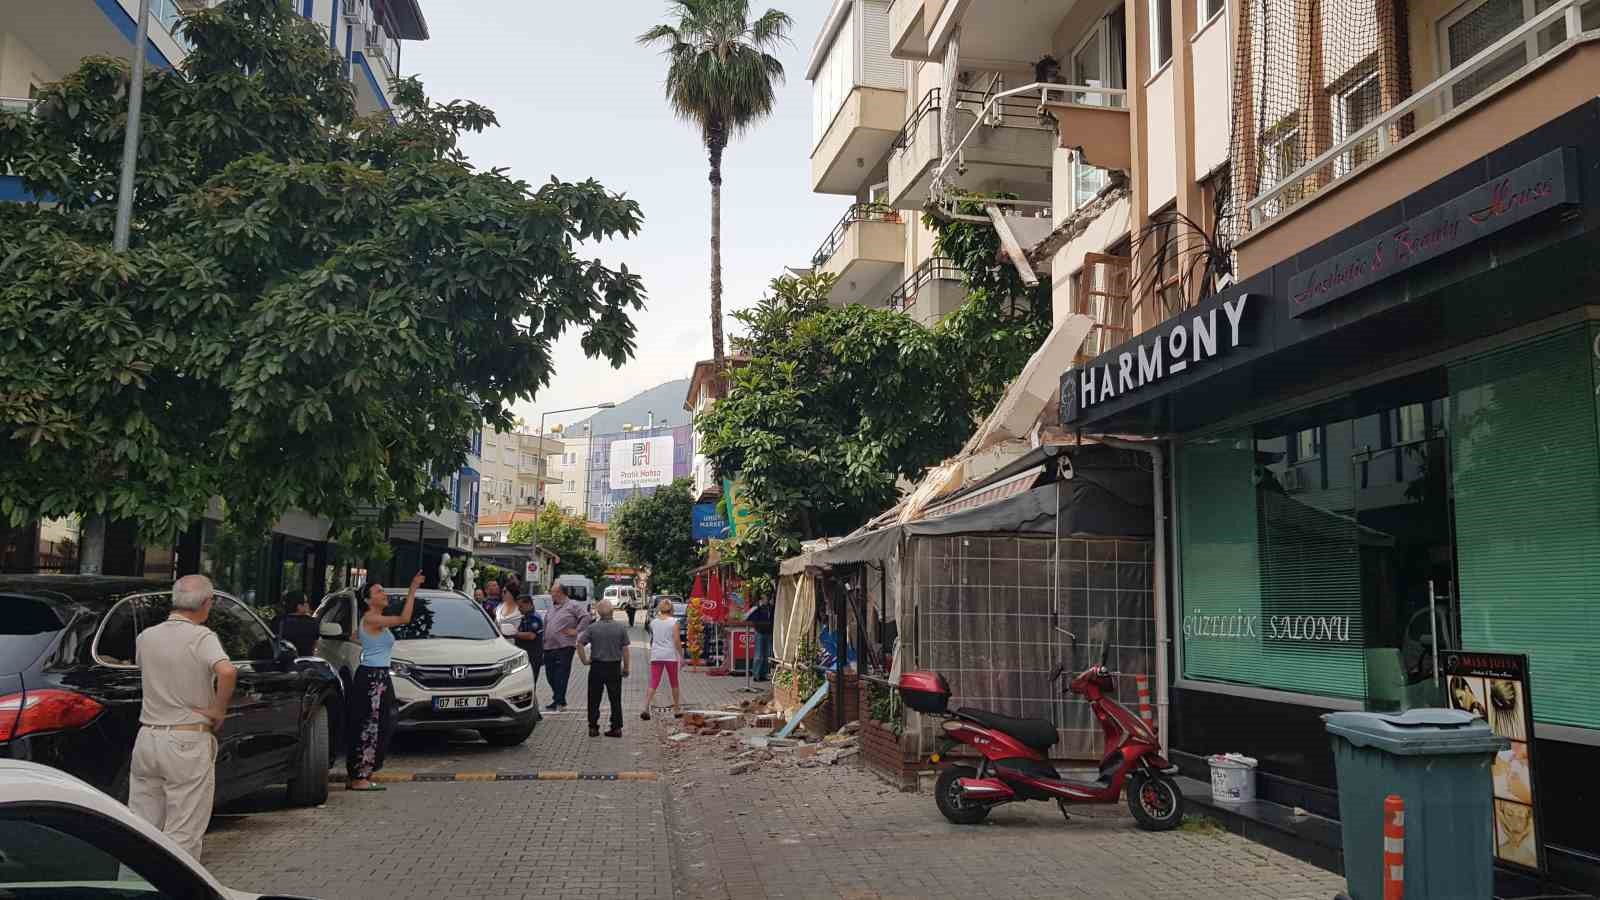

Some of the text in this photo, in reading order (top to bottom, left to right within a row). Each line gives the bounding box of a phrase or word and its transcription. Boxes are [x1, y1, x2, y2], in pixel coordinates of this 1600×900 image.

[1371, 239, 1384, 273] &
[1081, 293, 1248, 409] HARMONY
[1269, 615, 1350, 641] SALONU
[439, 698, 449, 708] 07
[476, 697, 488, 706] 07
